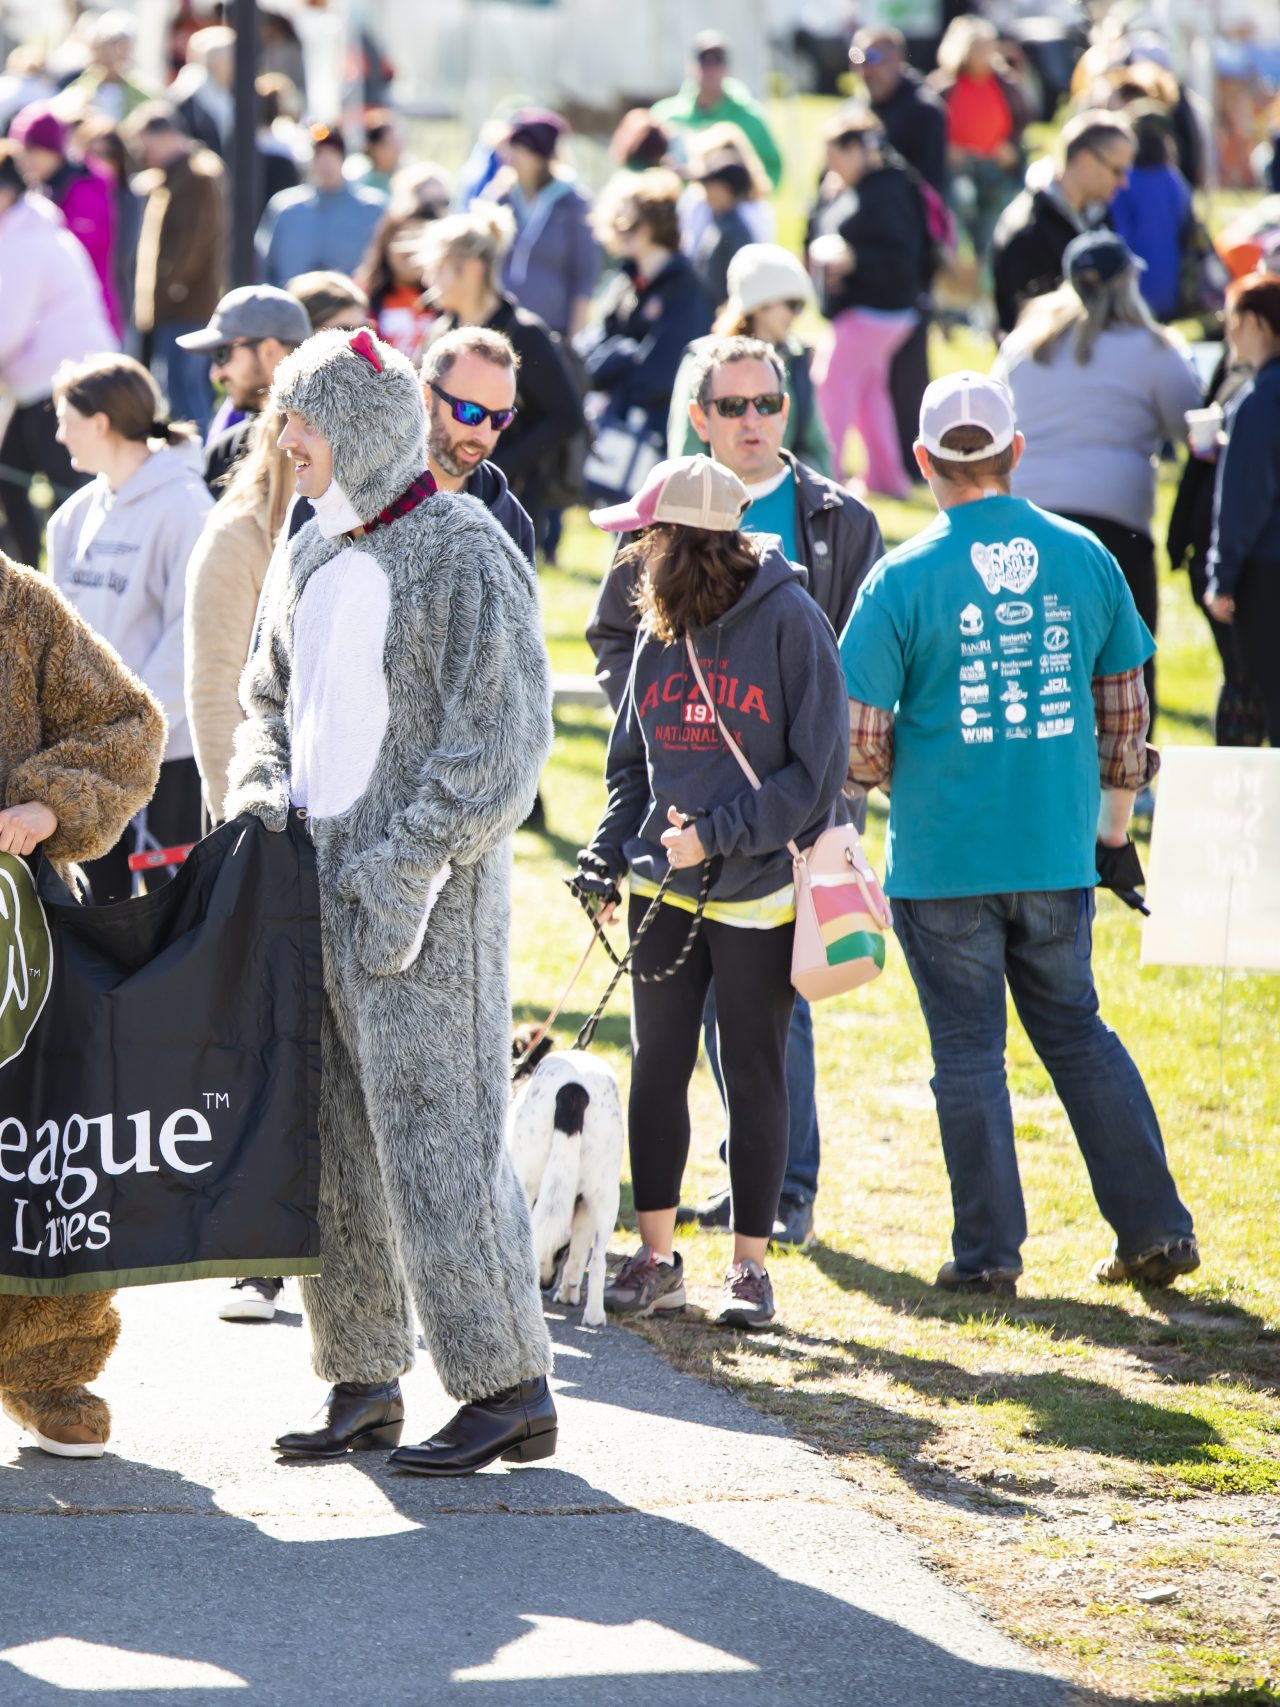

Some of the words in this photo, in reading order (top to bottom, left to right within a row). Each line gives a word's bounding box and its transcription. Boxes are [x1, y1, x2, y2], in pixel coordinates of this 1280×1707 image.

[29, 967, 41, 977] TM
[203, 1093, 230, 1109] TM
[11, 1198, 111, 1257] Lives
